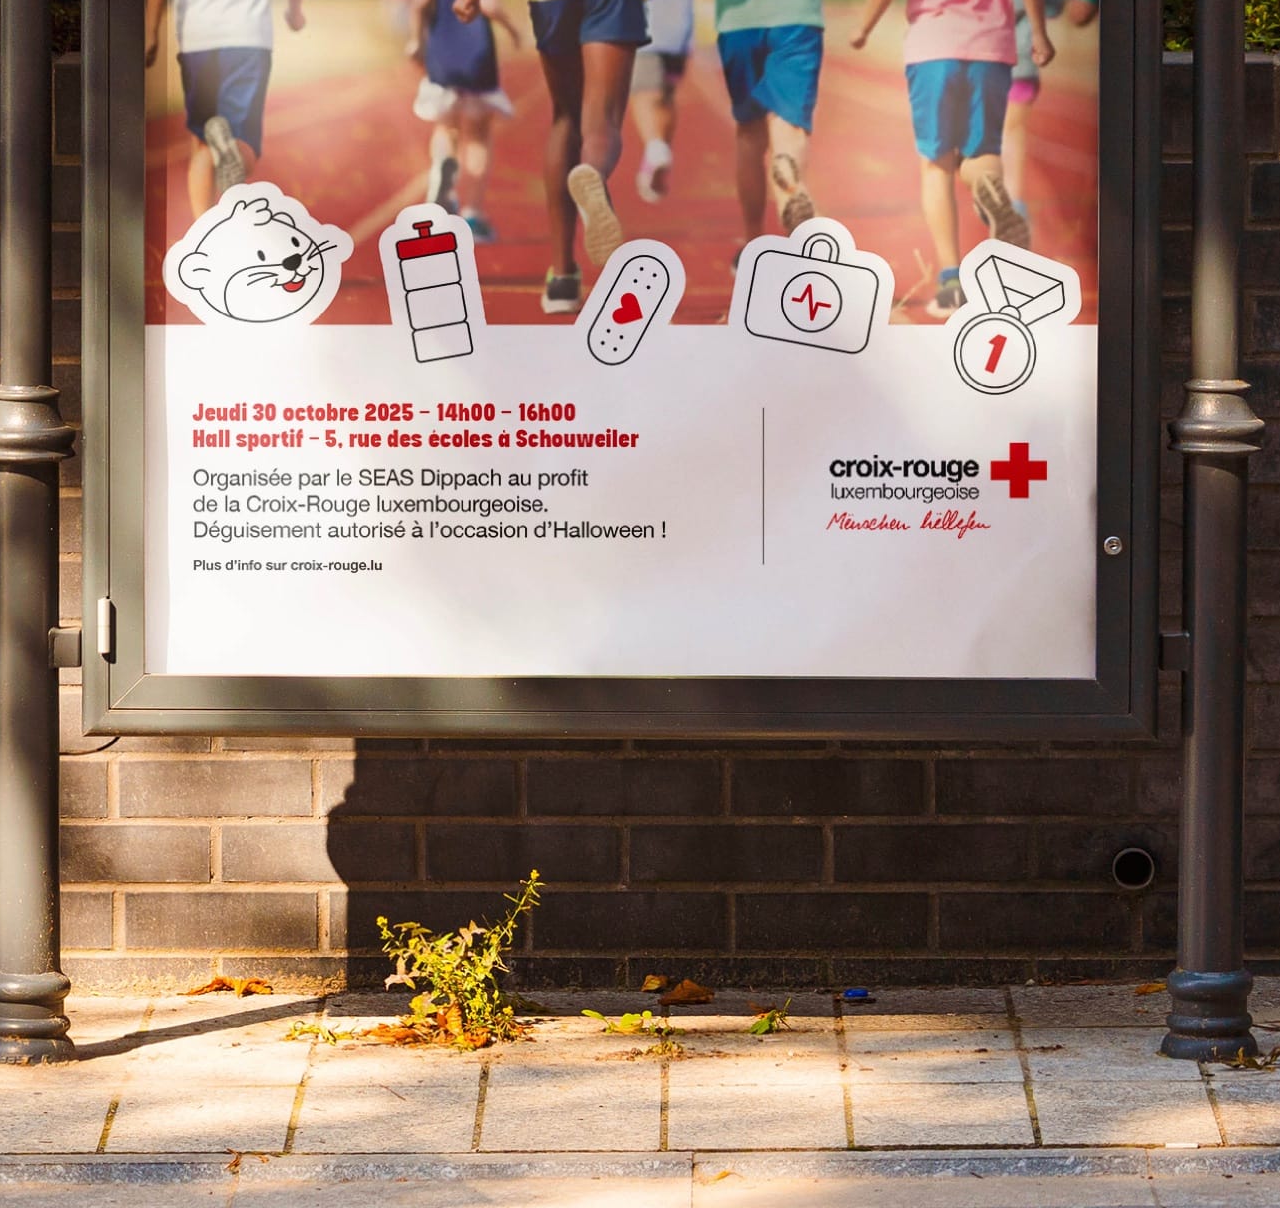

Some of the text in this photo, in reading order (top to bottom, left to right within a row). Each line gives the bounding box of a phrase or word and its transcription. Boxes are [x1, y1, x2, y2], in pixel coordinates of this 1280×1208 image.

[984, 334, 1008, 374] 1
[192, 403, 247, 421] Jeudi
[253, 403, 276, 421] 30
[282, 403, 359, 421] octobre
[364, 403, 414, 421] 2025
[437, 403, 495, 421] 14h00
[519, 403, 576, 421] 16h00
[192, 429, 230, 448] Hall
[235, 429, 304, 451] sportif
[325, 429, 343, 448] 5,
[349, 433, 381, 448] rue
[387, 429, 422, 448] des
[428, 429, 493, 448] écoles
[498, 429, 510, 448] à
[516, 429, 639, 448] Schouweiler
[193, 468, 589, 491] Organisée par le SEAS Dippach au profit
[829, 455, 980, 483] croix-rouge
[831, 483, 980, 504] luxembourgeoise
[193, 495, 548, 517] de la Croix-Rouge luxembourgeoise.
[193, 520, 321, 543] Déguisement
[327, 520, 406, 538] autorisé
[411, 520, 424, 538] à
[193, 559, 222, 571] Plus
[266, 562, 286, 571] sur
[290, 559, 383, 573] croix-rouge.lu
